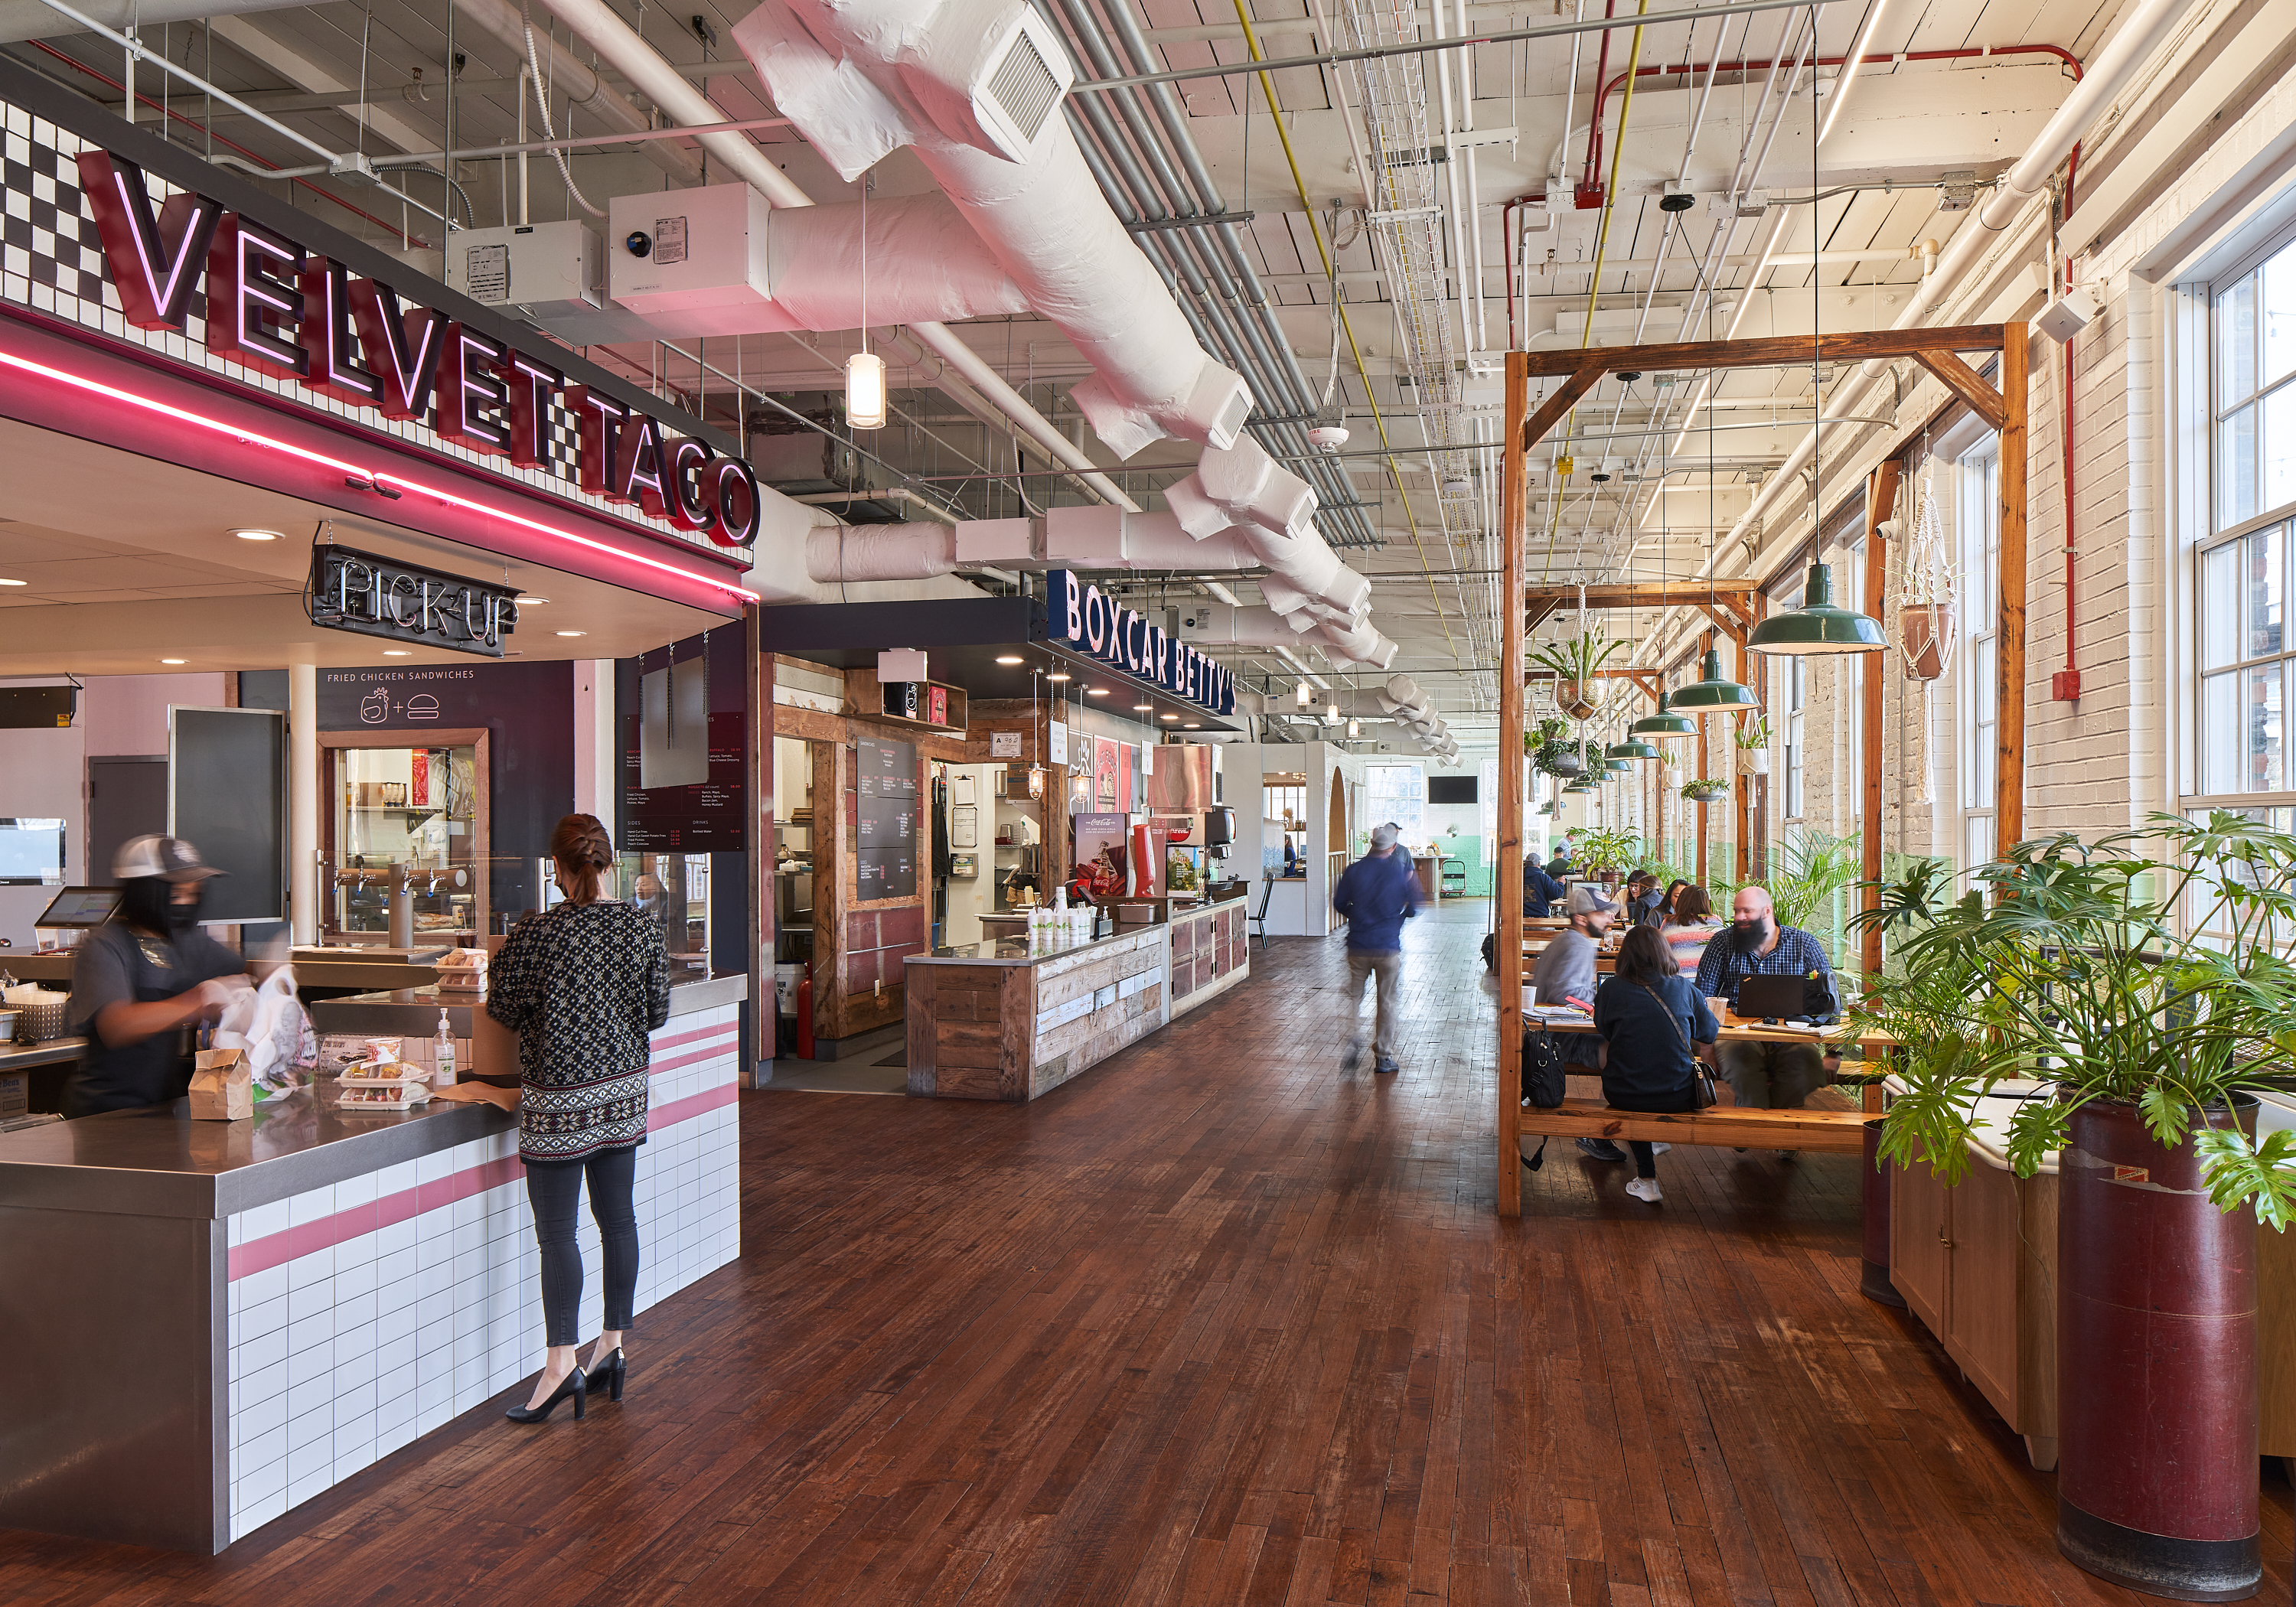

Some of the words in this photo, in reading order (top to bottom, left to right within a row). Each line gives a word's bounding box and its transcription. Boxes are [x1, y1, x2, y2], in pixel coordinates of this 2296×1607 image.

[74, 149, 565, 470] VELVET
[565, 384, 761, 548] TACO
[360, 673, 404, 681] CHICKEN
[409, 670, 474, 680] SANDWICHES
[1065, 569, 1167, 684] BOXCAR
[1176, 638, 1237, 715] BETTY'S
